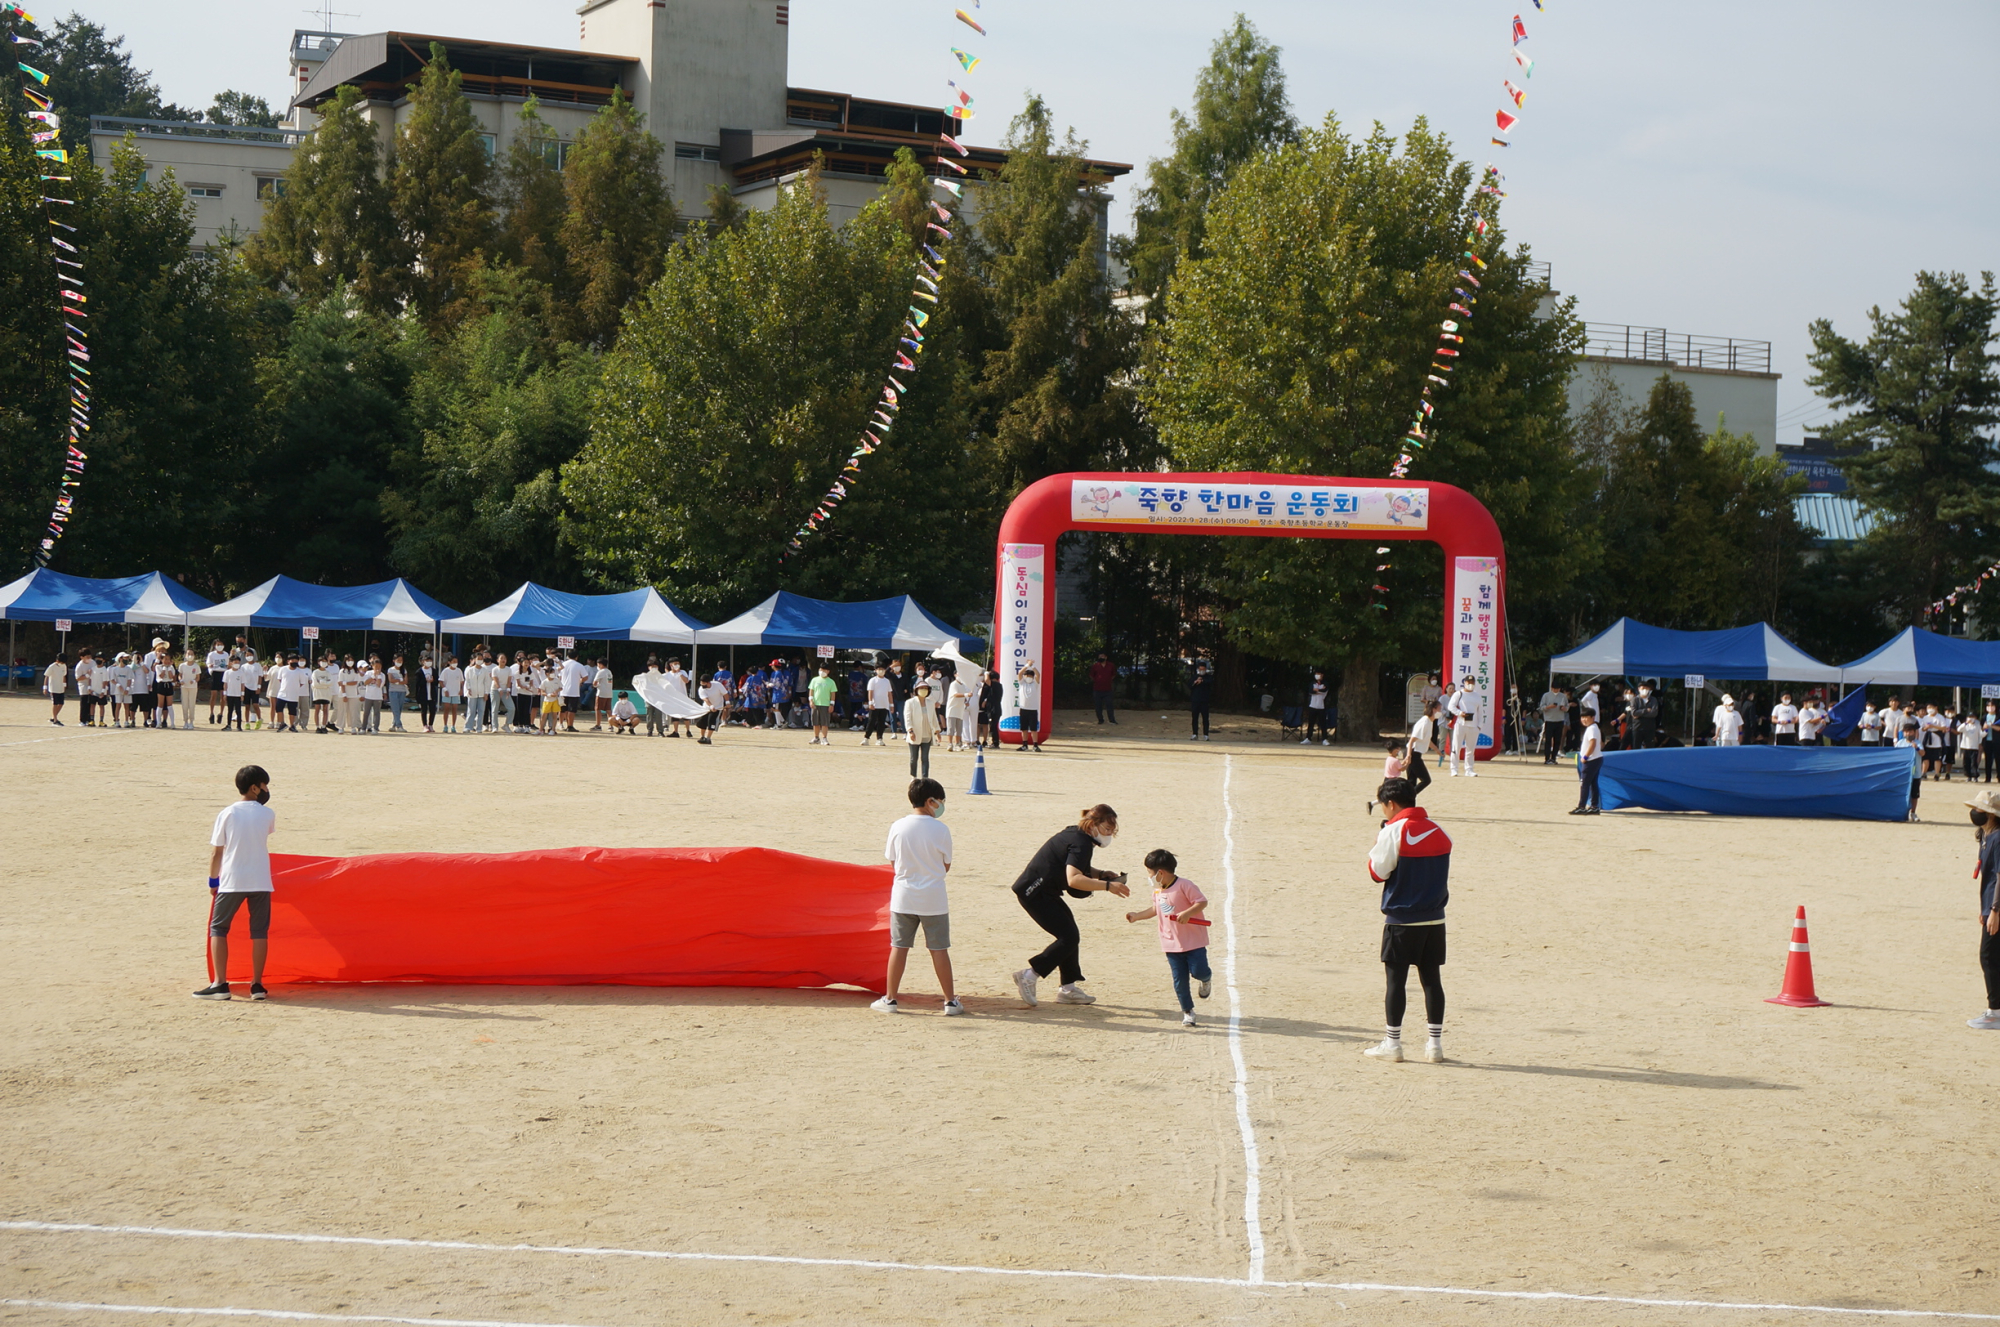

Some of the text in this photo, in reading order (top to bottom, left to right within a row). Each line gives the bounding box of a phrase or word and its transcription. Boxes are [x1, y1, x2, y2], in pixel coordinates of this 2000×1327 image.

[1138, 487, 1358, 516] 죽향 한마음 운동회
[1148, 515, 1166, 523] 일시:
[1259, 518, 1277, 526] 장소:
[1280, 519, 1324, 527] 죽향초등학교
[1327, 520, 1349, 528] 운동장
[1015, 566, 1028, 608] 동심이
[1478, 584, 1491, 609] 함께
[1460, 597, 1473, 623] 꿈과
[57, 619, 71, 630] 3학년
[304, 627, 318, 638] 4학년
[1477, 614, 1490, 657] 행복한
[558, 637, 574, 648] 5학년
[1459, 632, 1472, 658] 끼를
[1477, 661, 1490, 690] 죽향
[1686, 675, 1703, 687] 6학년
[1983, 686, 2000, 698] 5학년
